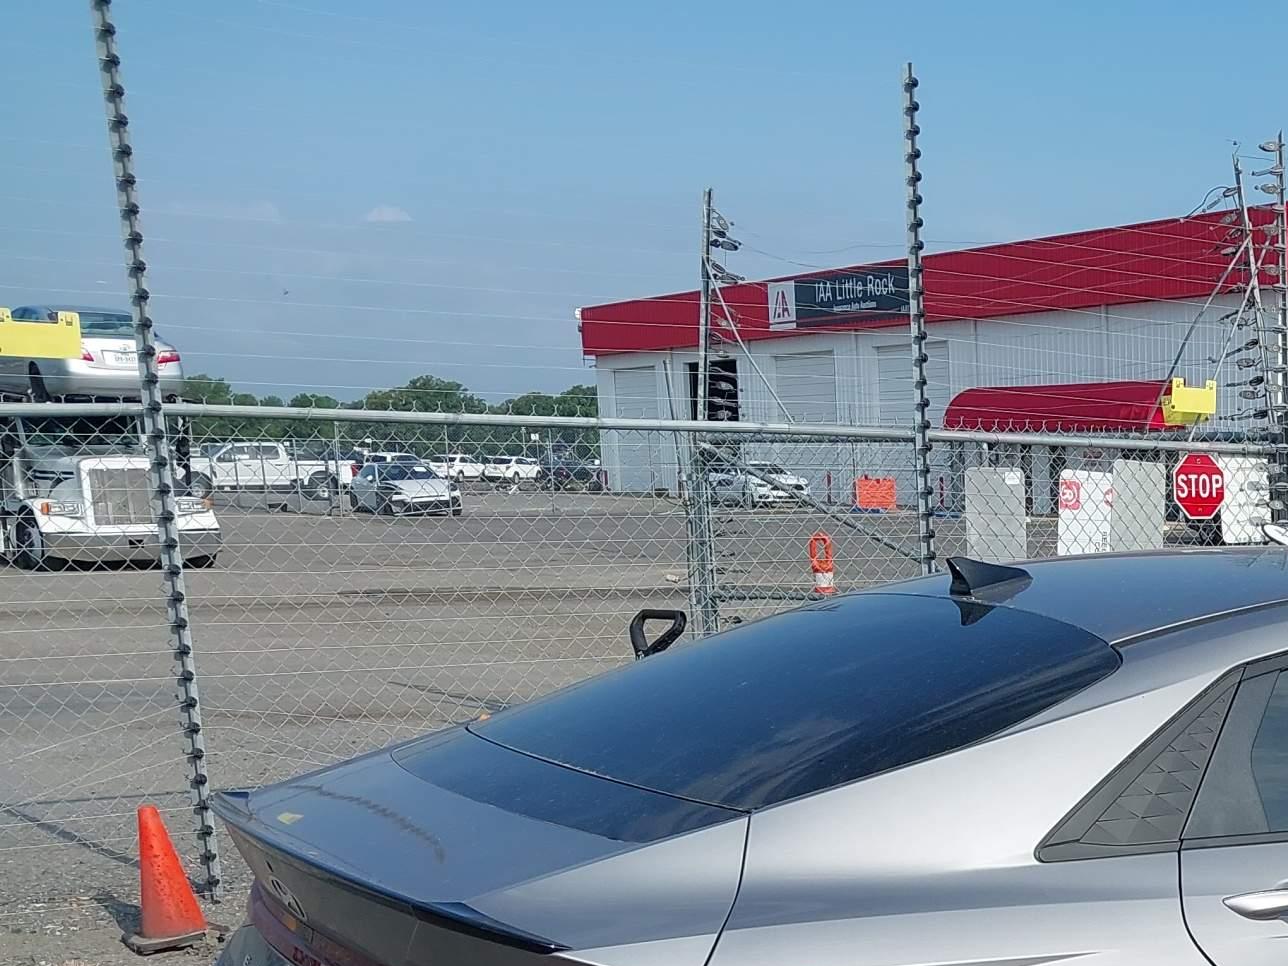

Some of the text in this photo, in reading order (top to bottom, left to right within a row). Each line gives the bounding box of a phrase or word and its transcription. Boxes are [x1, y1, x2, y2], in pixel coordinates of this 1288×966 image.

[816, 273, 896, 303] IAA Little Rock
[1177, 473, 1223, 499] STOP
